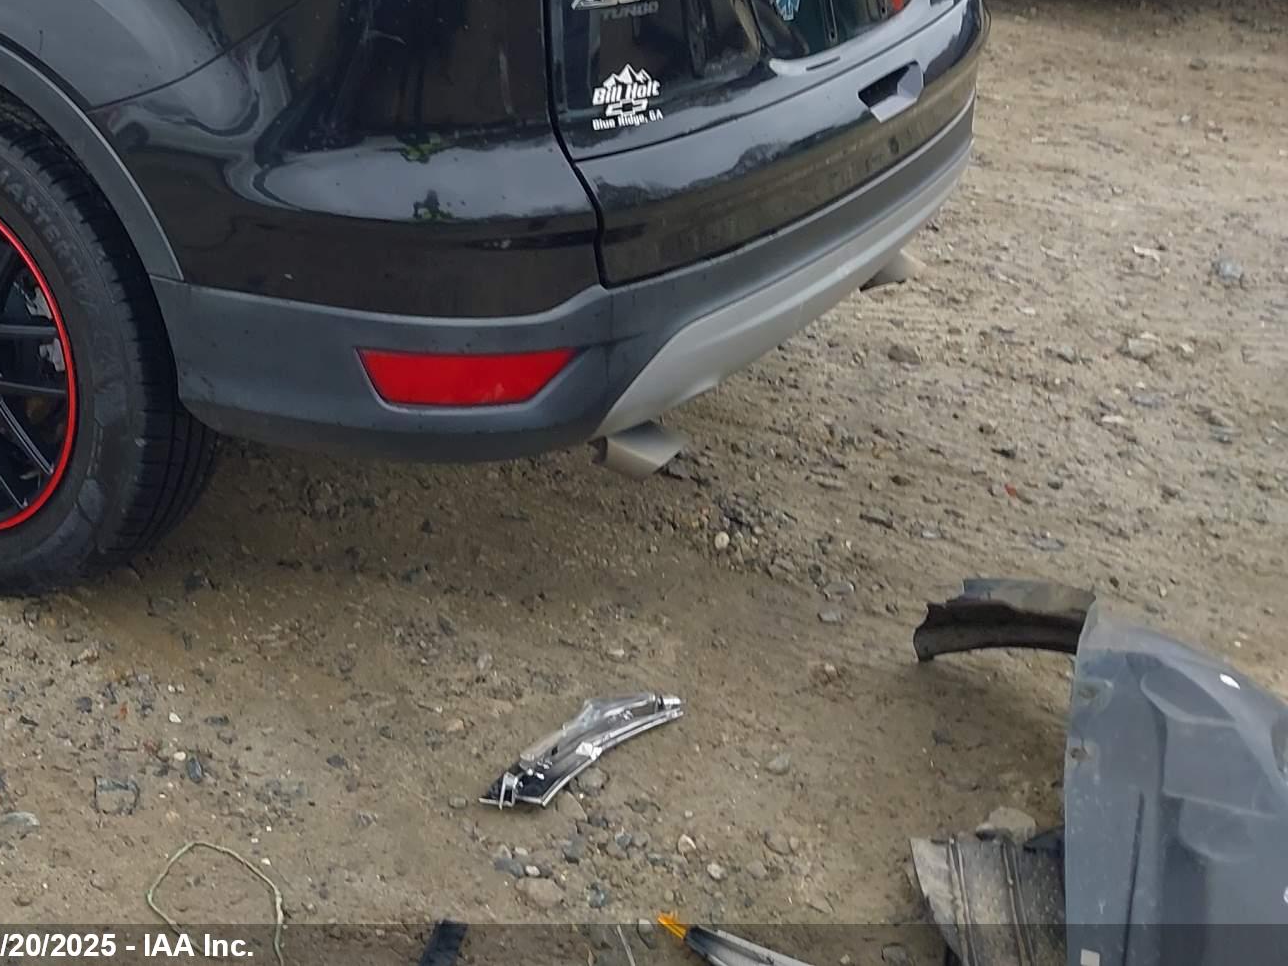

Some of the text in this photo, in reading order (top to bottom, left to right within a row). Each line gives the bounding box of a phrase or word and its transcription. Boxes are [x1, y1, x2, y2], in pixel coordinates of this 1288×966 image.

[592, 79, 661, 106] Bill Holt
[592, 118, 616, 131] Blue
